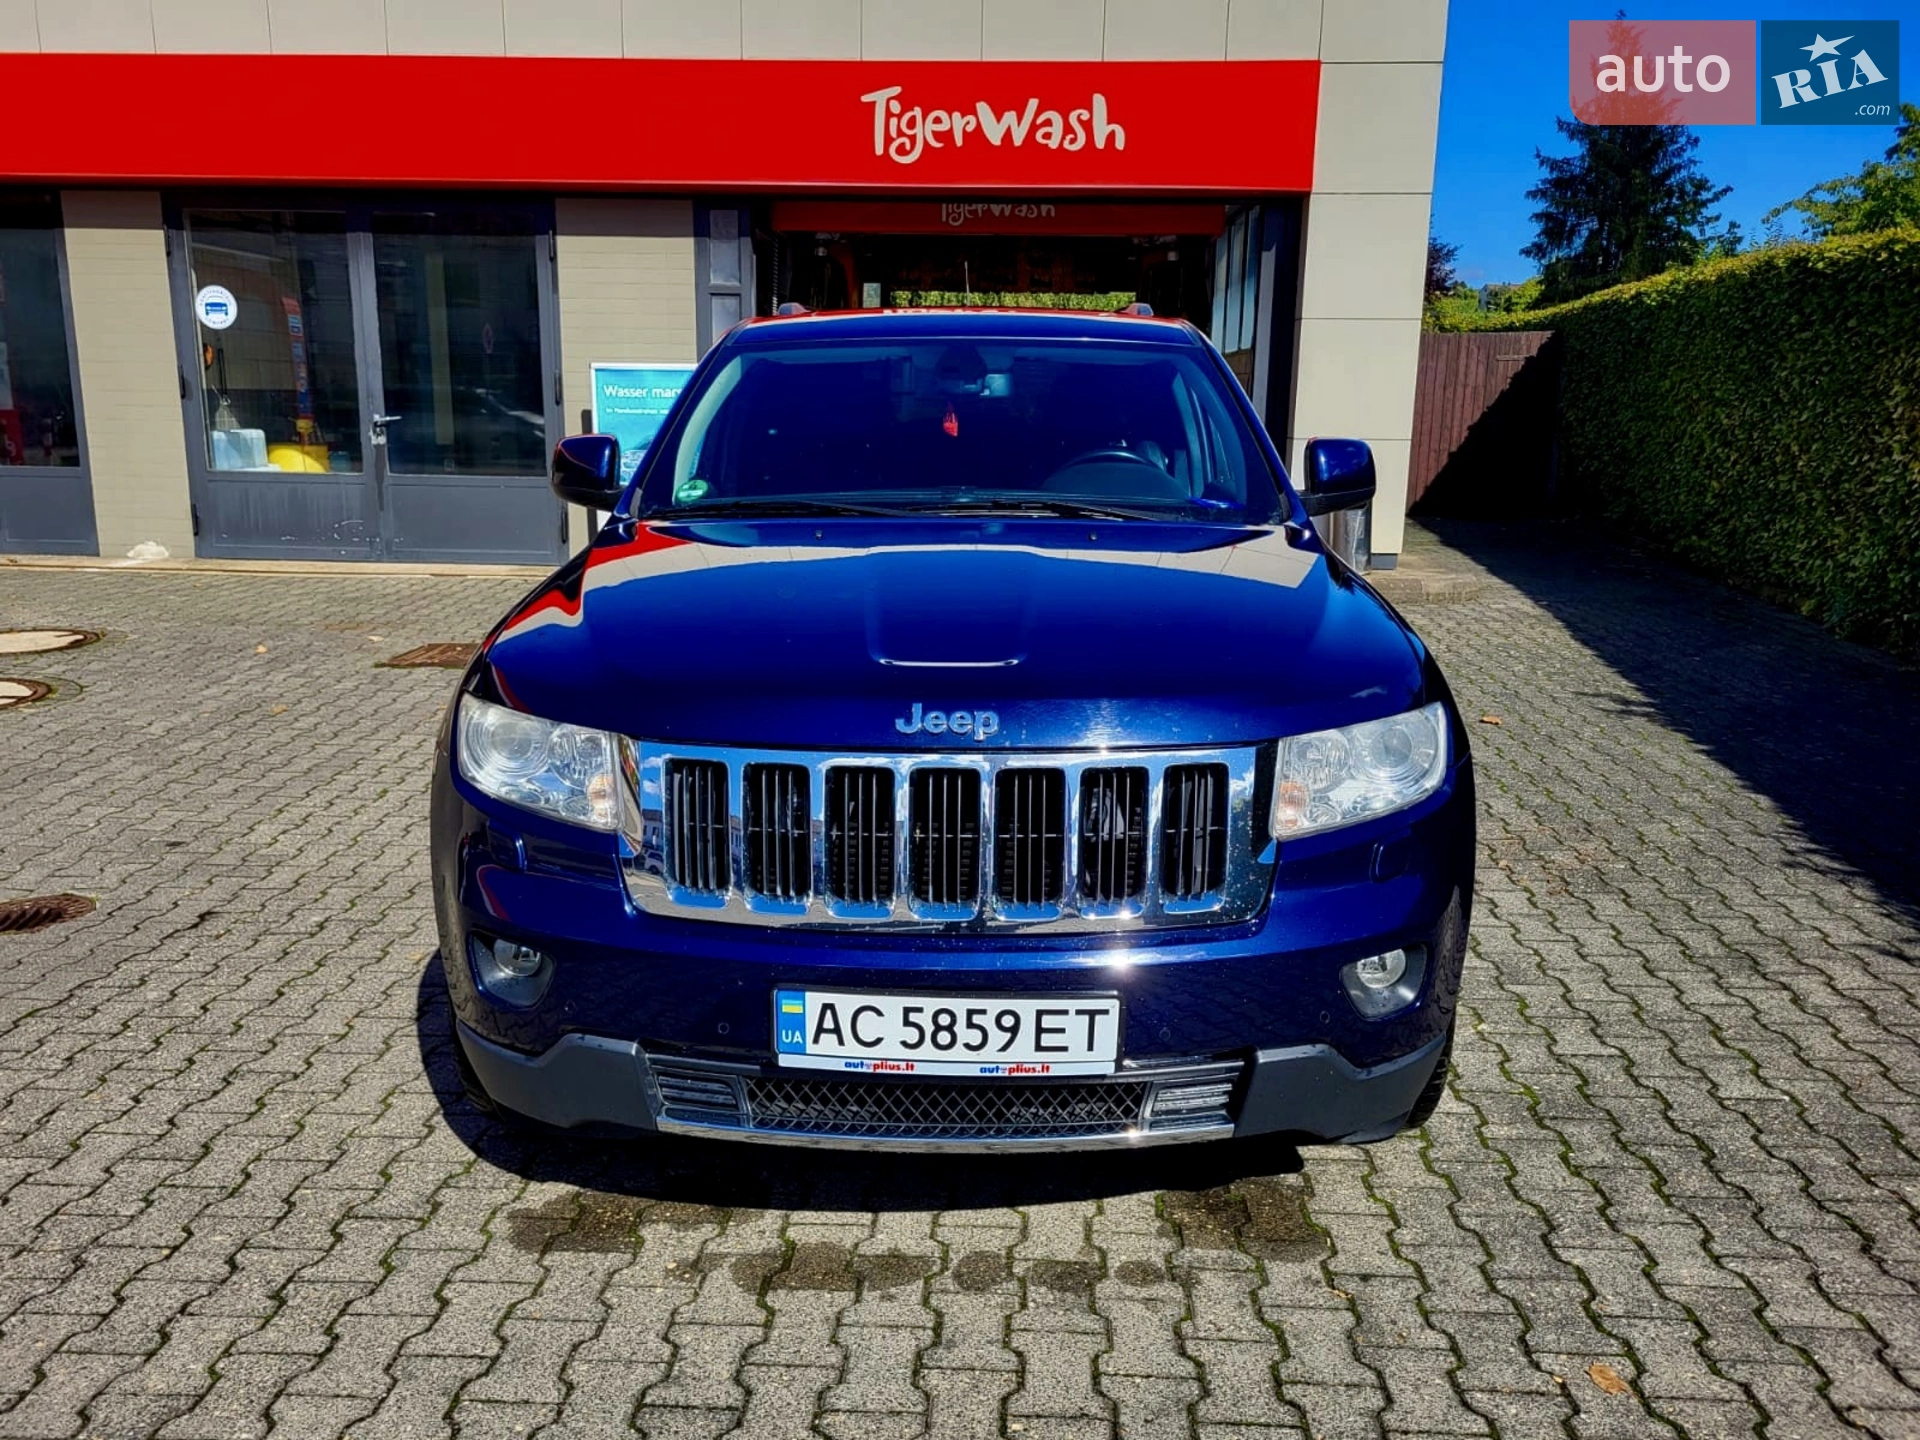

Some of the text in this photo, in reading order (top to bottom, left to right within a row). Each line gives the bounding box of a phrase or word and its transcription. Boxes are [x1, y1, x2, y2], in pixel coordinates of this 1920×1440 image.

[860, 86, 1126, 164] TigerWash
[603, 384, 648, 398] Wasser
[895, 702, 1000, 741] Jeep
[781, 1029, 804, 1044] UA
[812, 1003, 1110, 1053] AC 5859 ET
